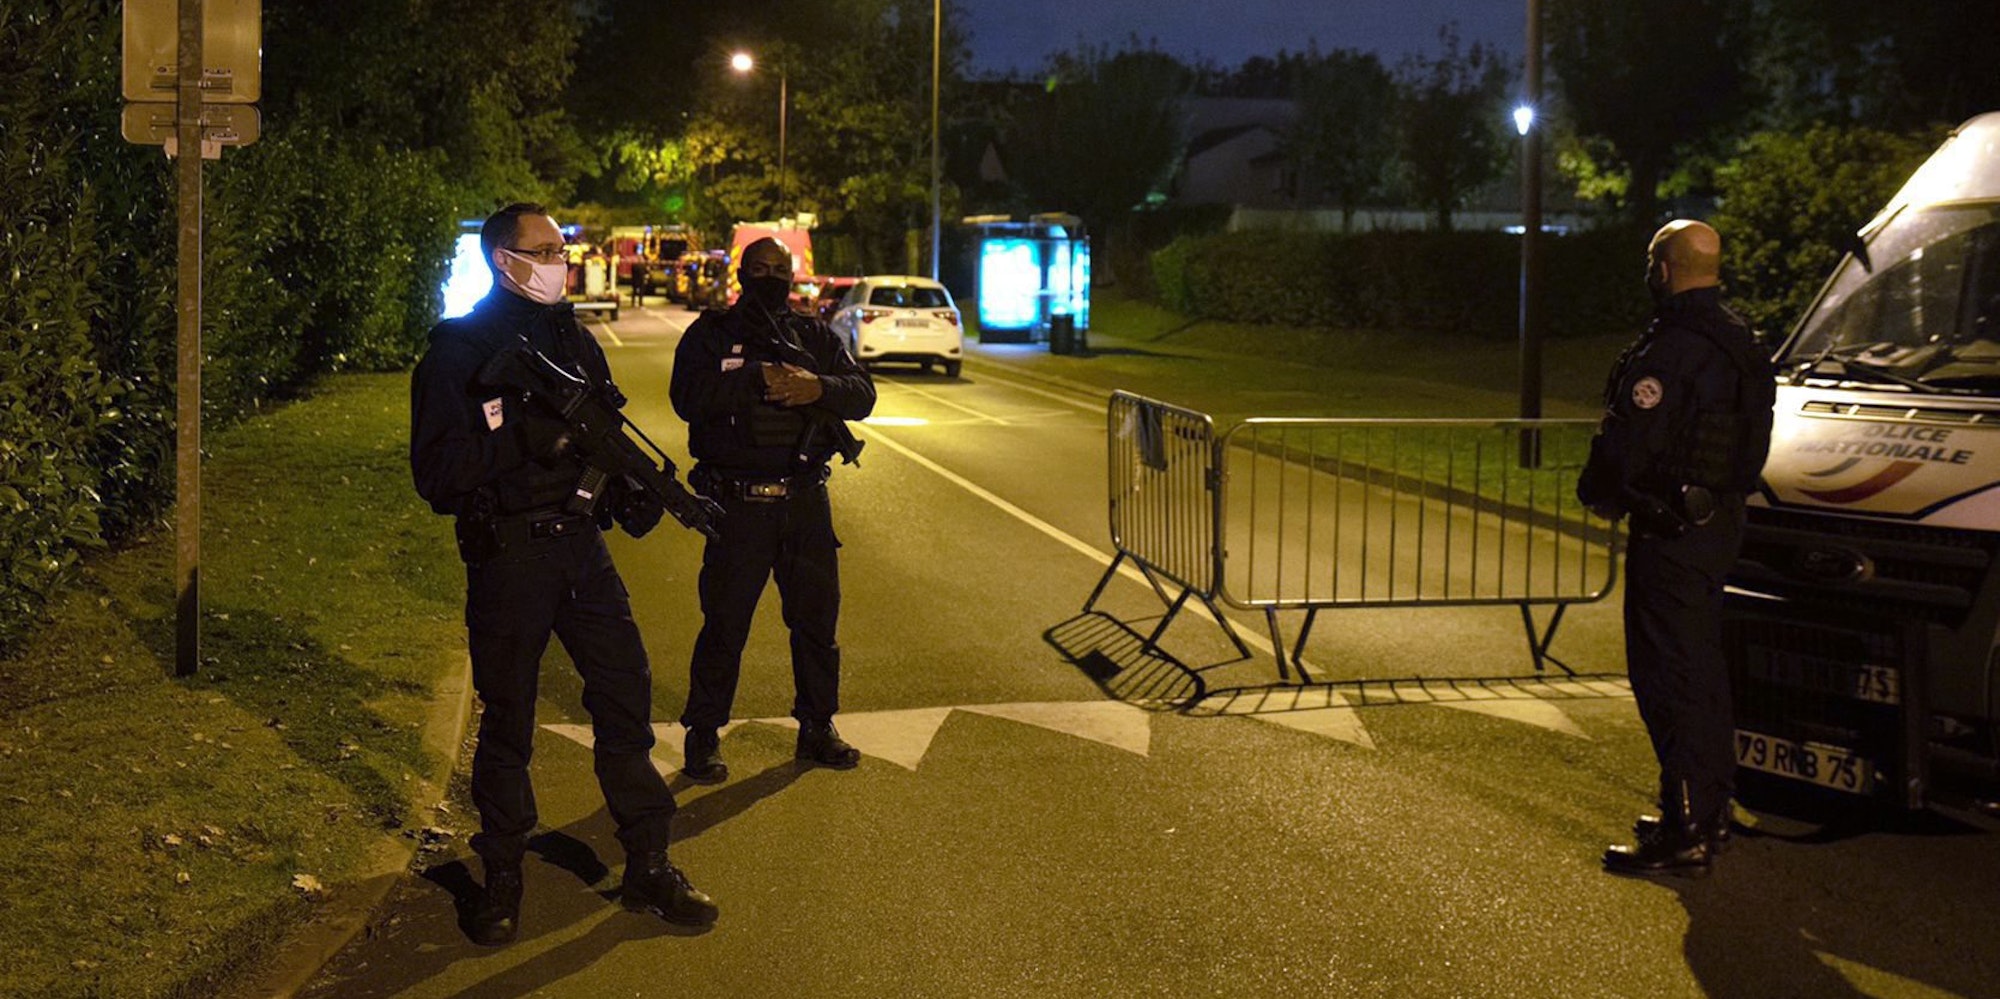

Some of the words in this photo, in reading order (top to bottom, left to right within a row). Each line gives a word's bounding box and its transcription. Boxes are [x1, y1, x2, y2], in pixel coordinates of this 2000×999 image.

[1853, 424, 1953, 443] OLICE
[1859, 667, 1890, 697] 75
[1738, 734, 1767, 765] 79
[1826, 755, 1857, 789] 75
